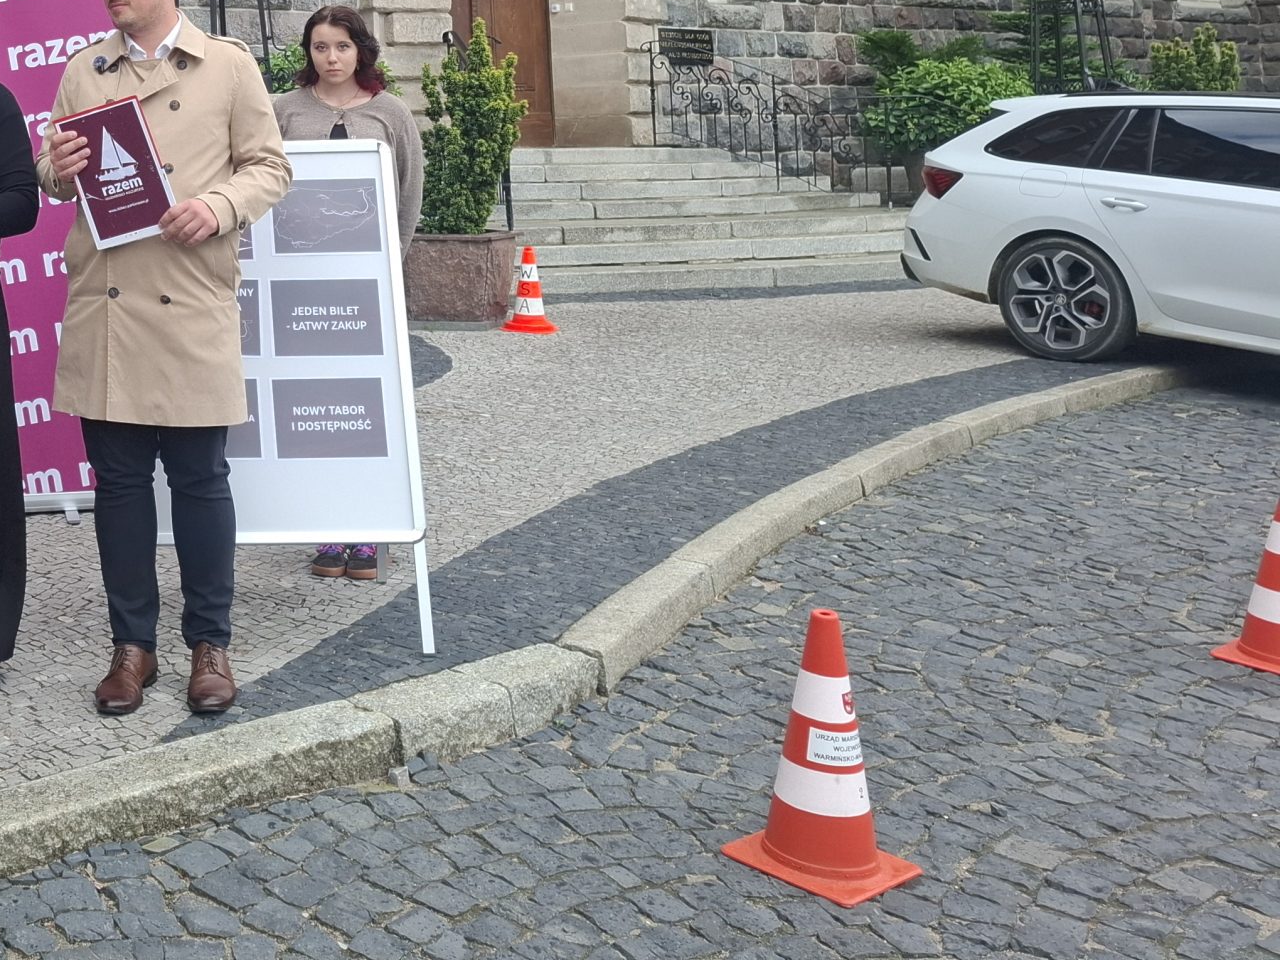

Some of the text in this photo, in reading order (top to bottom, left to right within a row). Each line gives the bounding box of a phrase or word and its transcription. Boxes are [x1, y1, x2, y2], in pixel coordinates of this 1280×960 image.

[101, 177, 143, 197] razem
[291, 306, 360, 316] JEDEN BILET
[292, 321, 329, 331] ŁATWY
[331, 320, 368, 330] ZAKUP
[292, 405, 366, 416] NOWY TABOR
[297, 418, 372, 433] DOSTĘPNOŚĆ
[815, 733, 840, 743] URZĄD
